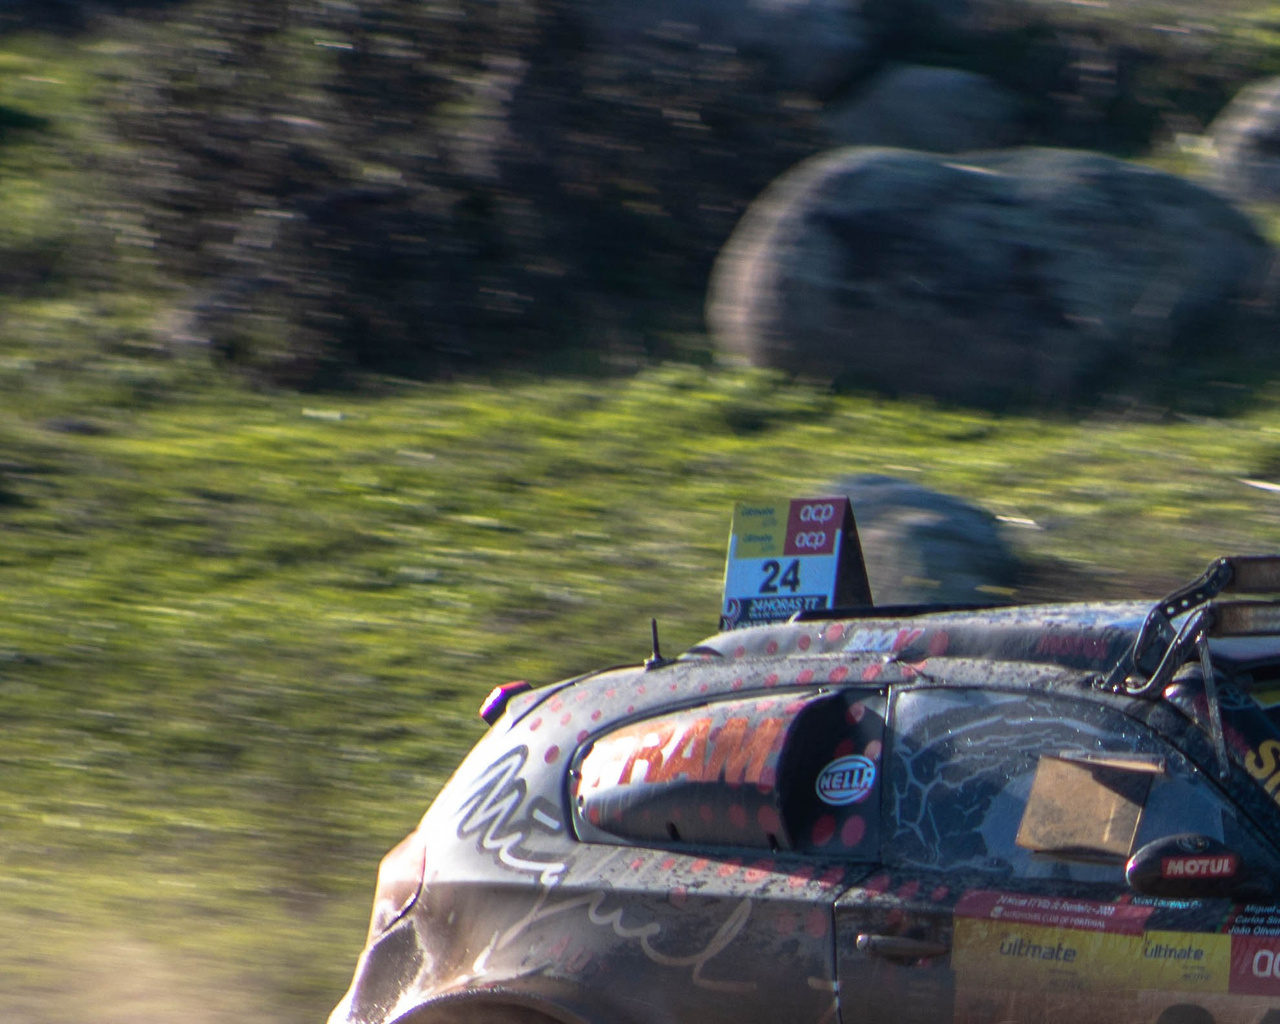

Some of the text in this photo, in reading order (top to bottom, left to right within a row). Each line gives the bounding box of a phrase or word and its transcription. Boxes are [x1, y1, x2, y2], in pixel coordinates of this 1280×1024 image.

[800, 504, 834, 525] acp
[795, 531, 826, 550] acp
[759, 559, 800, 593] 24
[819, 765, 875, 792] HELLA
[1166, 858, 1231, 876] MOTUL
[1244, 904, 1275, 914] Miguel
[1235, 915, 1264, 925] Carlos
[1228, 926, 1251, 935] João
